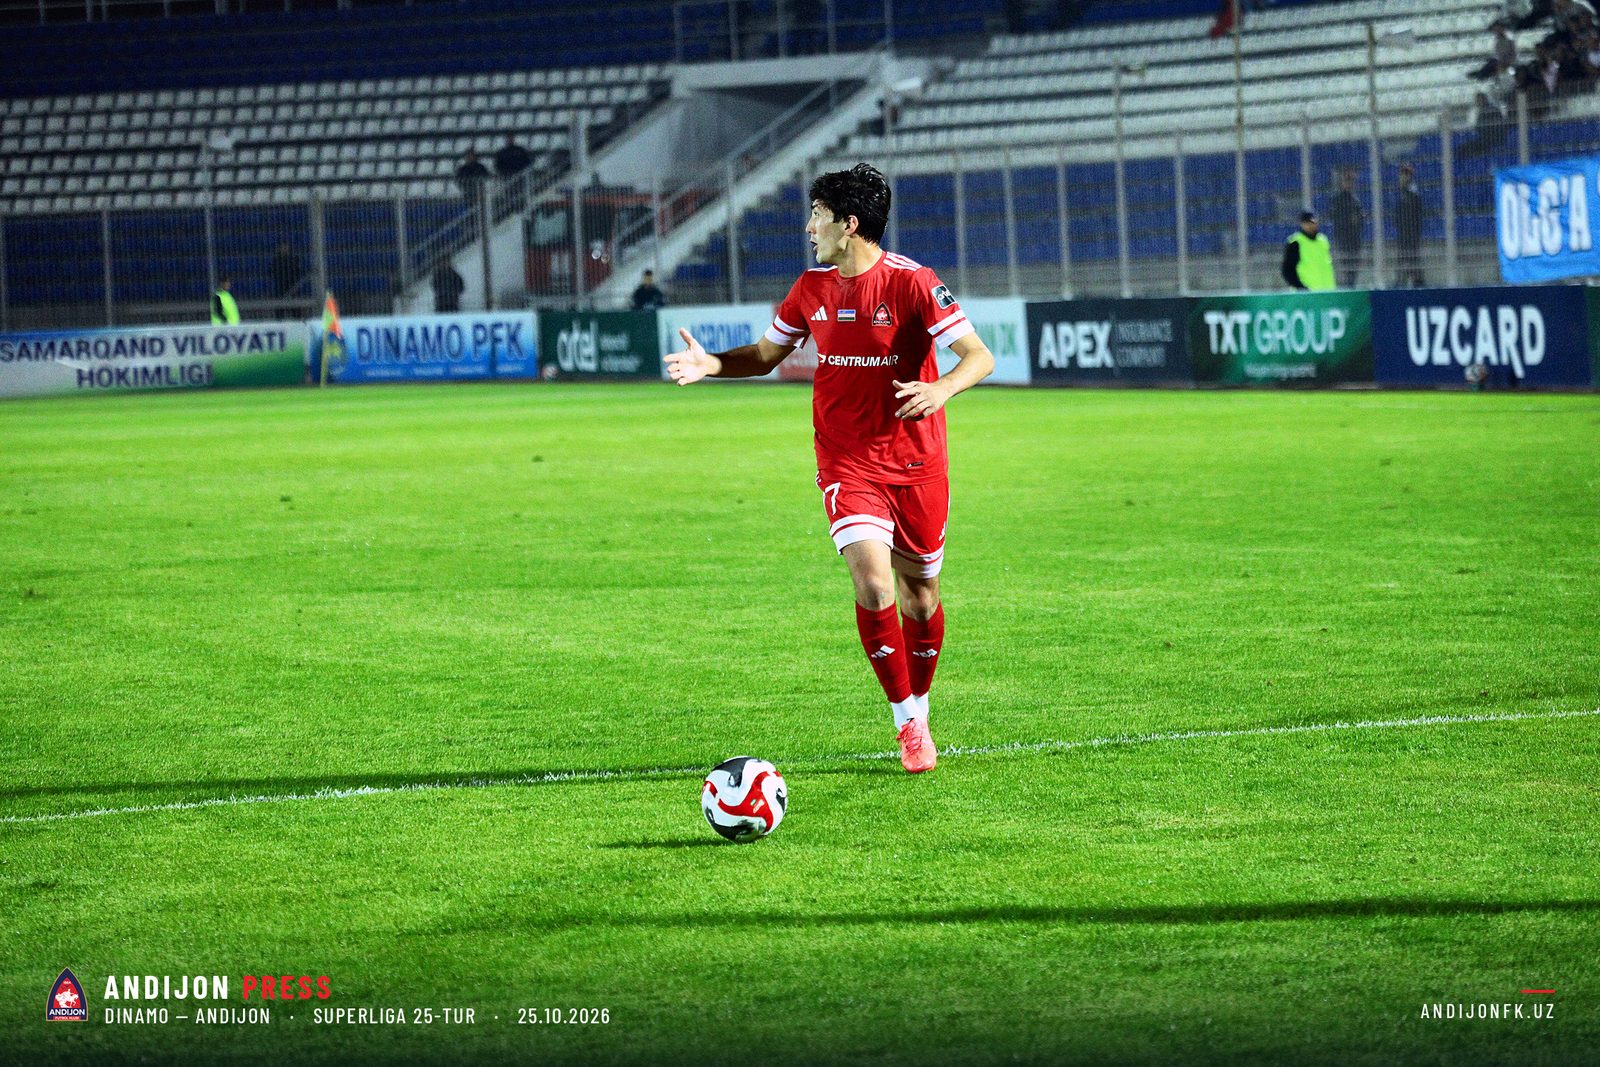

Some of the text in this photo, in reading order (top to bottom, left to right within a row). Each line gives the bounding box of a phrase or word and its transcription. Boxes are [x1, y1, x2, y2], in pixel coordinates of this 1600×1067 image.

[0, 331, 286, 363] SAMARQAND VILOYATI
[356, 320, 526, 363] DINAMO PFK
[1039, 322, 1114, 368] APEX
[1204, 308, 1346, 355] TXT GROUP
[1405, 305, 1545, 379] UZCARD
[76, 363, 214, 388] HOKIMLIGI
[828, 354, 899, 366] CENTRUM AIR
